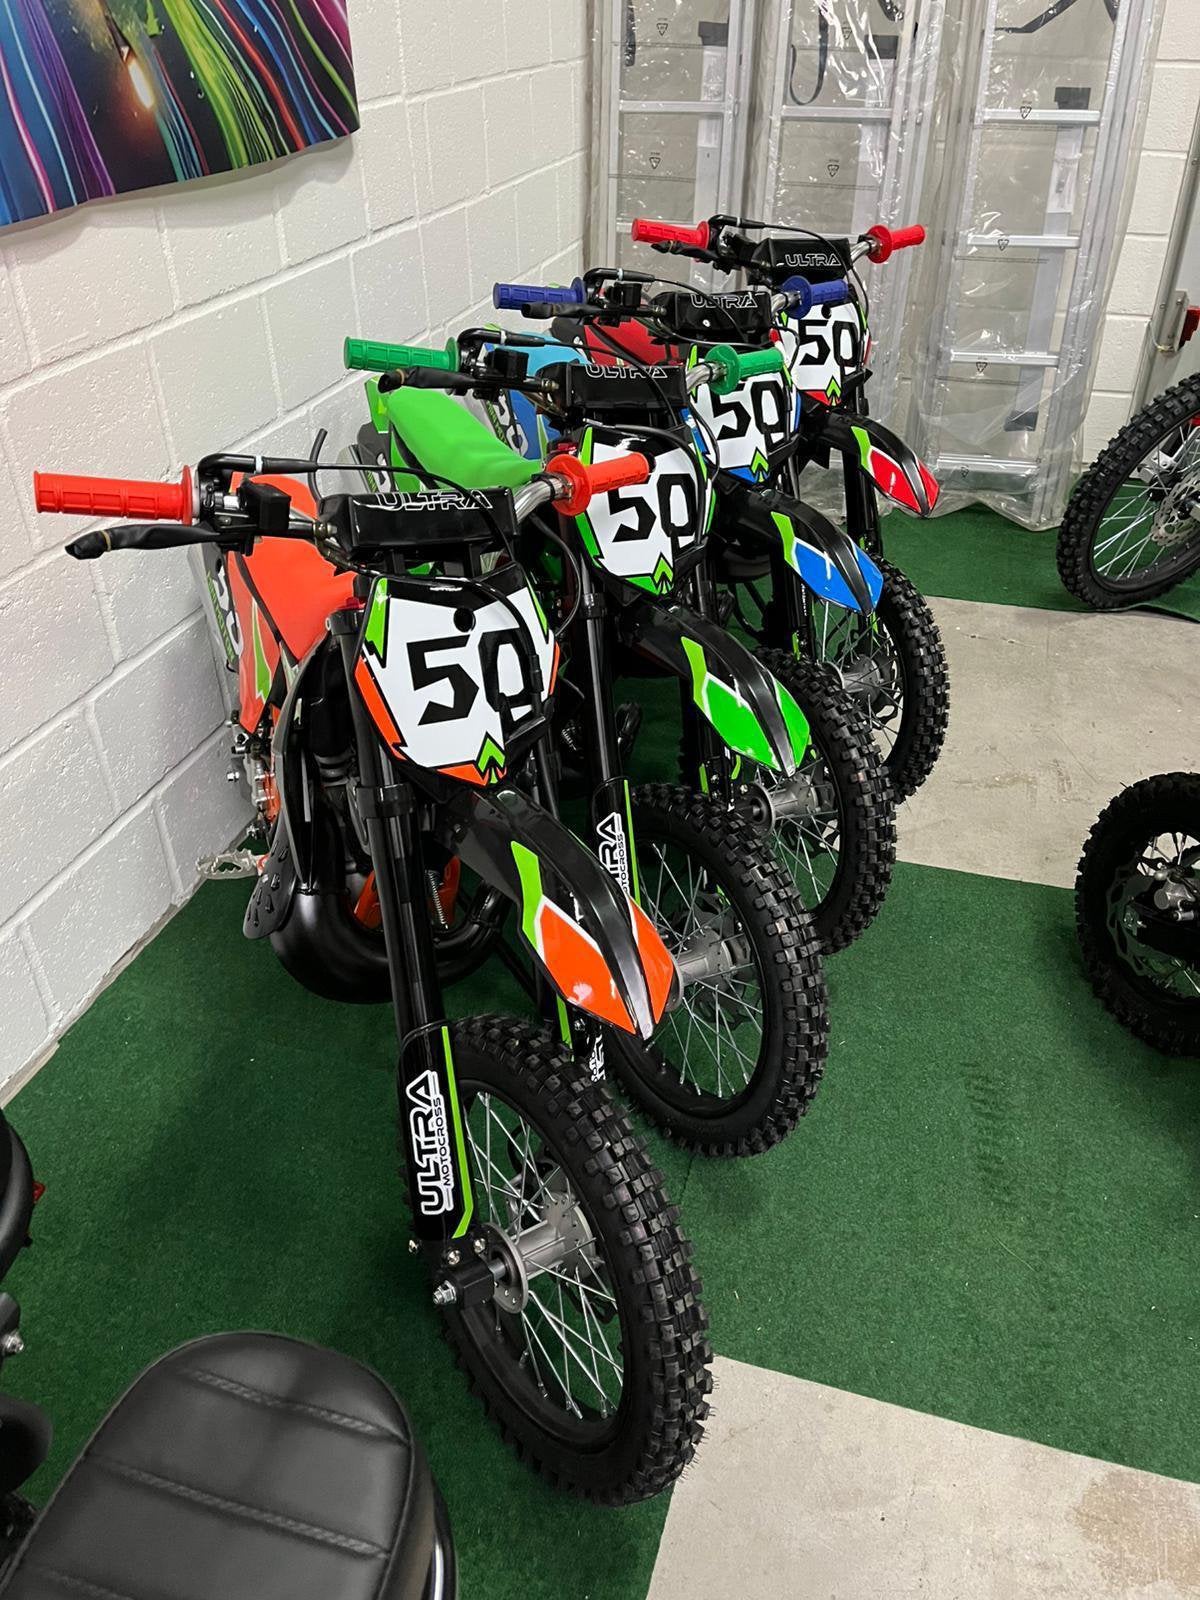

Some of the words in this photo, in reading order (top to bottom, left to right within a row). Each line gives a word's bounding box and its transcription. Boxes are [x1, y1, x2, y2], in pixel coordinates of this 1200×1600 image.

[785, 252, 842, 267] ULTRA
[690, 292, 758, 309] ULTRA
[798, 319, 860, 366] 50
[585, 364, 668, 379] ULTRA
[710, 380, 788, 441] 50
[376, 489, 493, 512] ULTRA
[607, 473, 698, 543] 50
[406, 628, 537, 726] 50
[406, 1071, 448, 1214] ULTRA
[432, 1096, 452, 1187] MOTOCROSS
